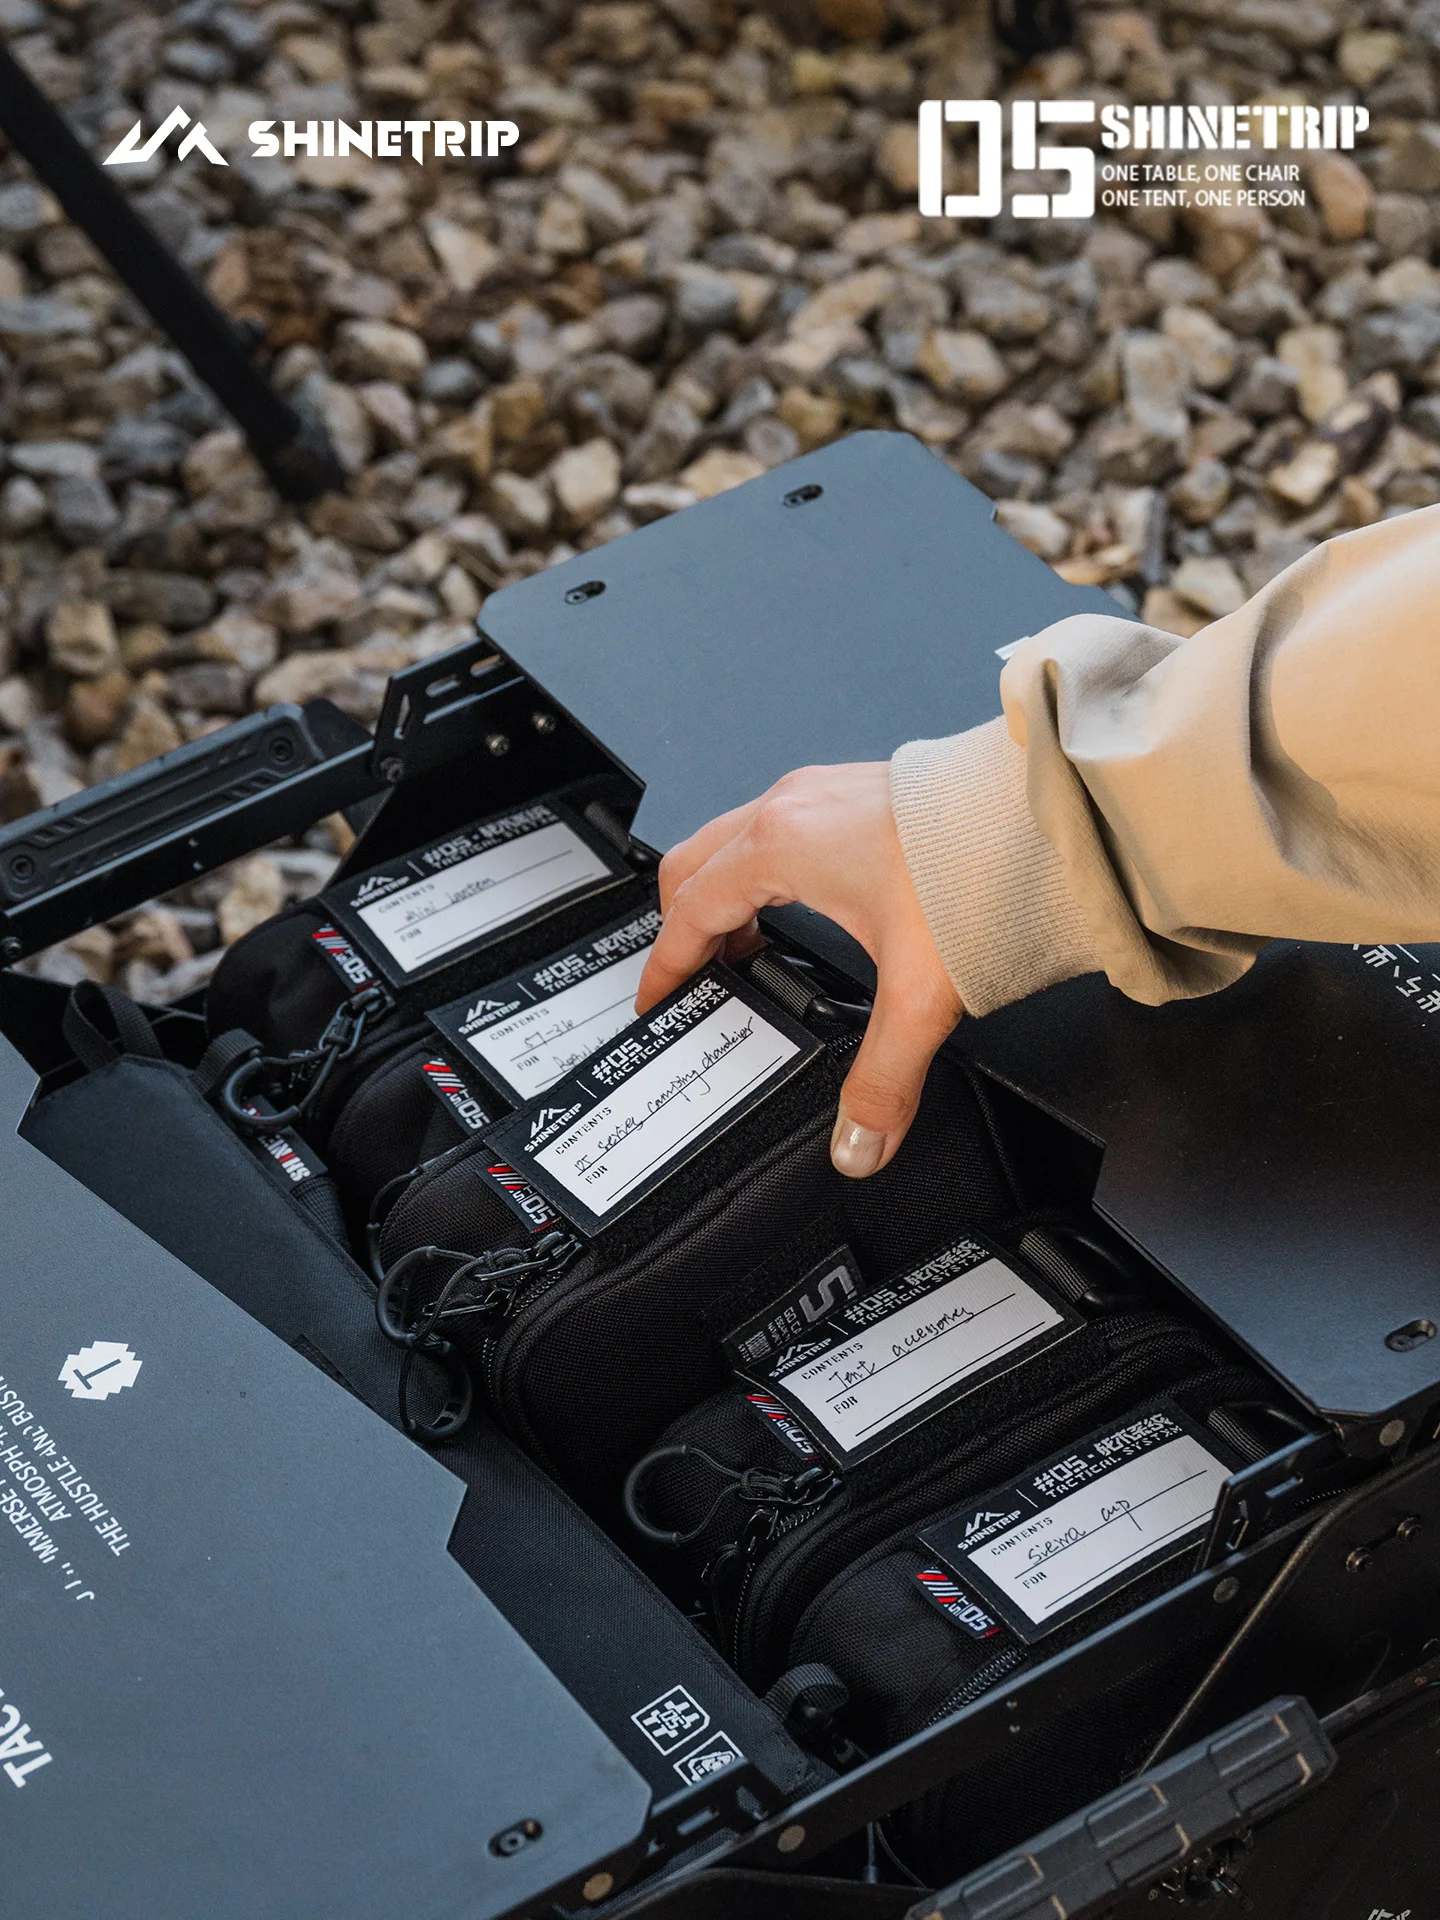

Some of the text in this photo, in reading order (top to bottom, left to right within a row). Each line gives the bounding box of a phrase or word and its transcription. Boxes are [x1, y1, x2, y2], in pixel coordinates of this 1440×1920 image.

[378, 883, 435, 914] CONTENTS
[533, 954, 586, 986] #05
[544, 954, 617, 993] TACTICAL
[458, 1001, 521, 1035] SHINETRIP
[490, 1008, 549, 1041] CONTENTS
[516, 1056, 540, 1071] FOR
[592, 1037, 643, 1081] #05
[602, 1034, 674, 1086] TACTICAL
[457, 1100, 490, 1129] 05
[524, 1103, 582, 1152] SHINETRIP
[555, 1106, 612, 1156] CONTENTS
[585, 1165, 608, 1185] FOR
[521, 1195, 555, 1224] 05
[843, 1287, 898, 1322] #05
[855, 1285, 931, 1326] TACTICAL
[769, 1337, 832, 1378] SHINETRIP
[801, 1341, 864, 1380] CONTENTS
[828, 1360, 876, 1390] Tent
[833, 1396, 859, 1414] FOR
[47, 1456, 109, 1522] HUSTLE
[1033, 1455, 1088, 1492] #05
[1045, 1457, 1122, 1498] TACTICAL
[95, 1517, 131, 1557] THE
[957, 1509, 1022, 1551] SHINETRIP
[990, 1517, 1053, 1556] CONTENTS
[1022, 1571, 1047, 1589] FOR
[958, 1605, 995, 1631] 05
